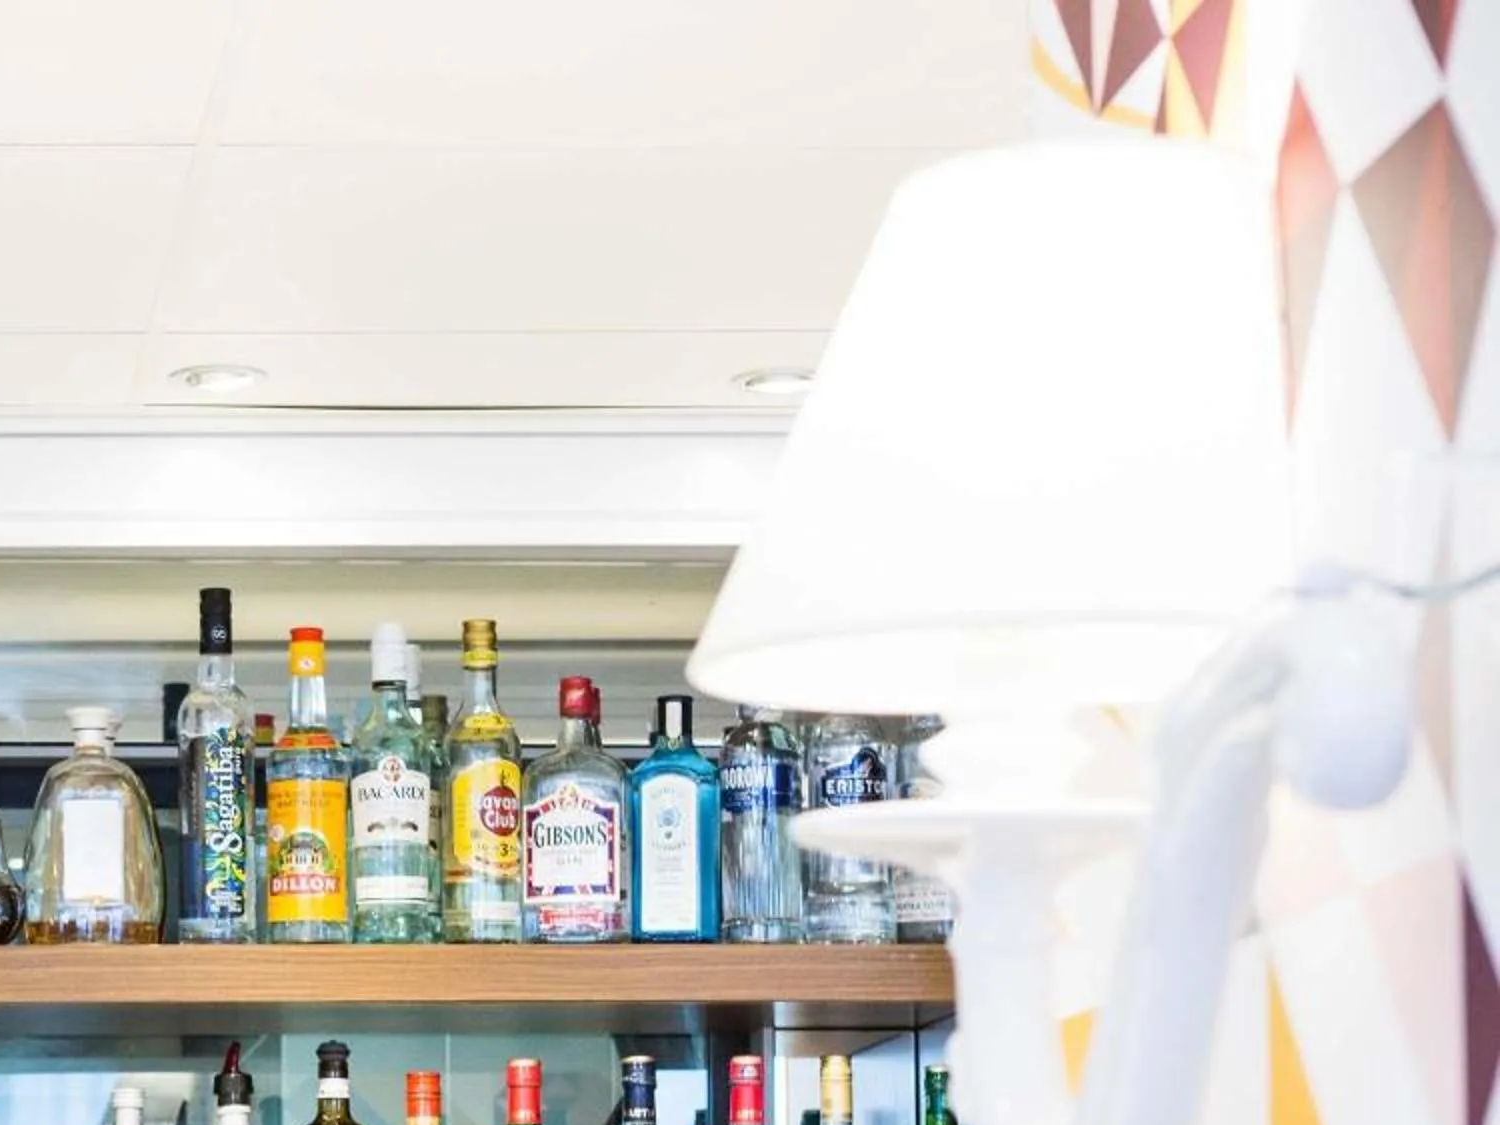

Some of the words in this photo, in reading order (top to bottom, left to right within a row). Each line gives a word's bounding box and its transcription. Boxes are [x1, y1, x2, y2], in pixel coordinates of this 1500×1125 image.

[209, 746, 243, 854] Sagatiba
[357, 785, 426, 802] BACARDI
[484, 811, 516, 829] Club
[271, 876, 338, 893] DILLON
